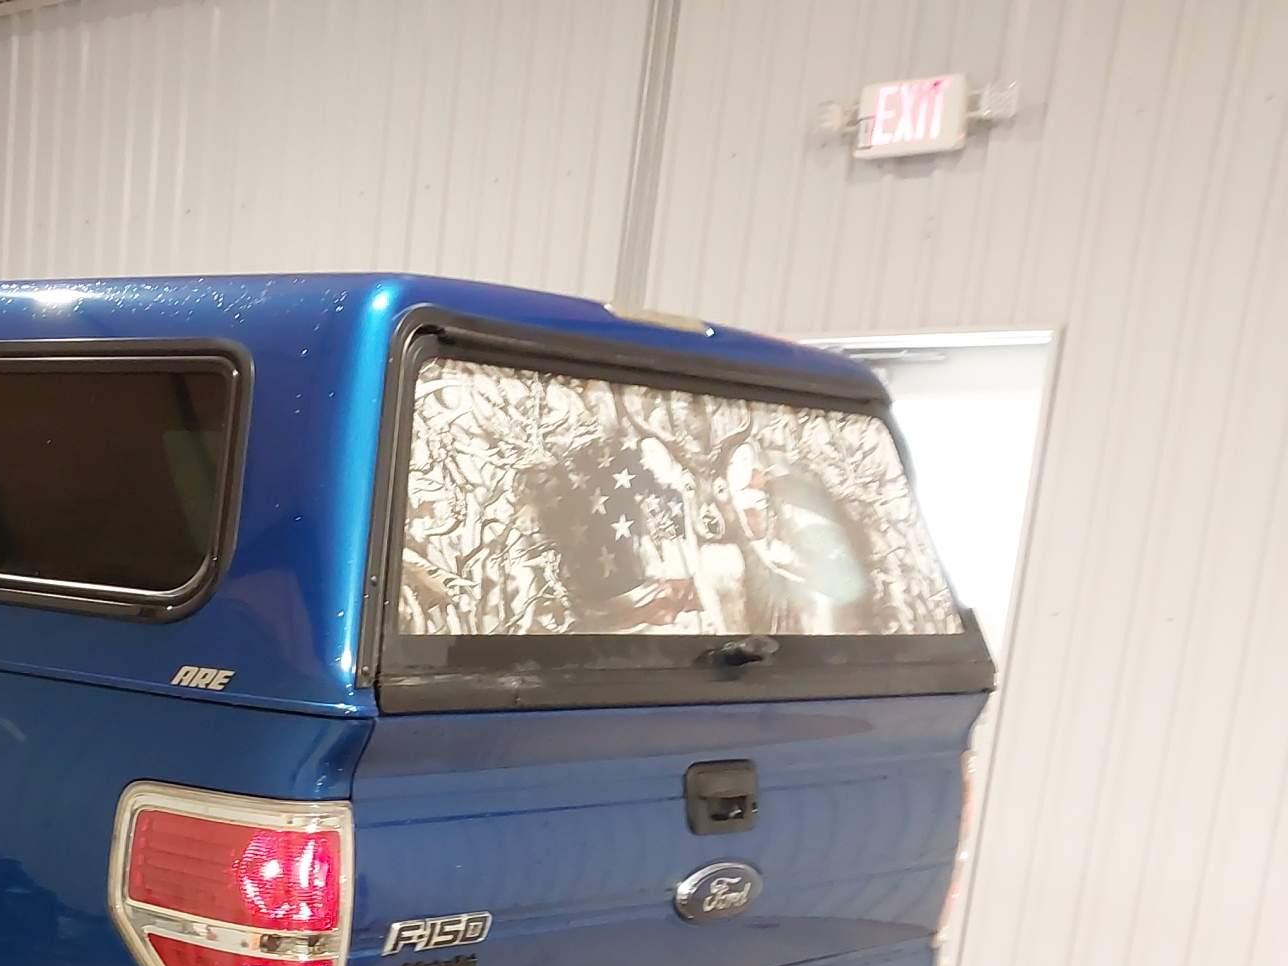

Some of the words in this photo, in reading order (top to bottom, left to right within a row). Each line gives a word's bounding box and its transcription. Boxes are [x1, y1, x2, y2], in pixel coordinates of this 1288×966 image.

[871, 77, 953, 146] EXIT
[169, 665, 236, 691] ARE
[702, 876, 753, 913] Ford
[381, 910, 493, 958] F-150
